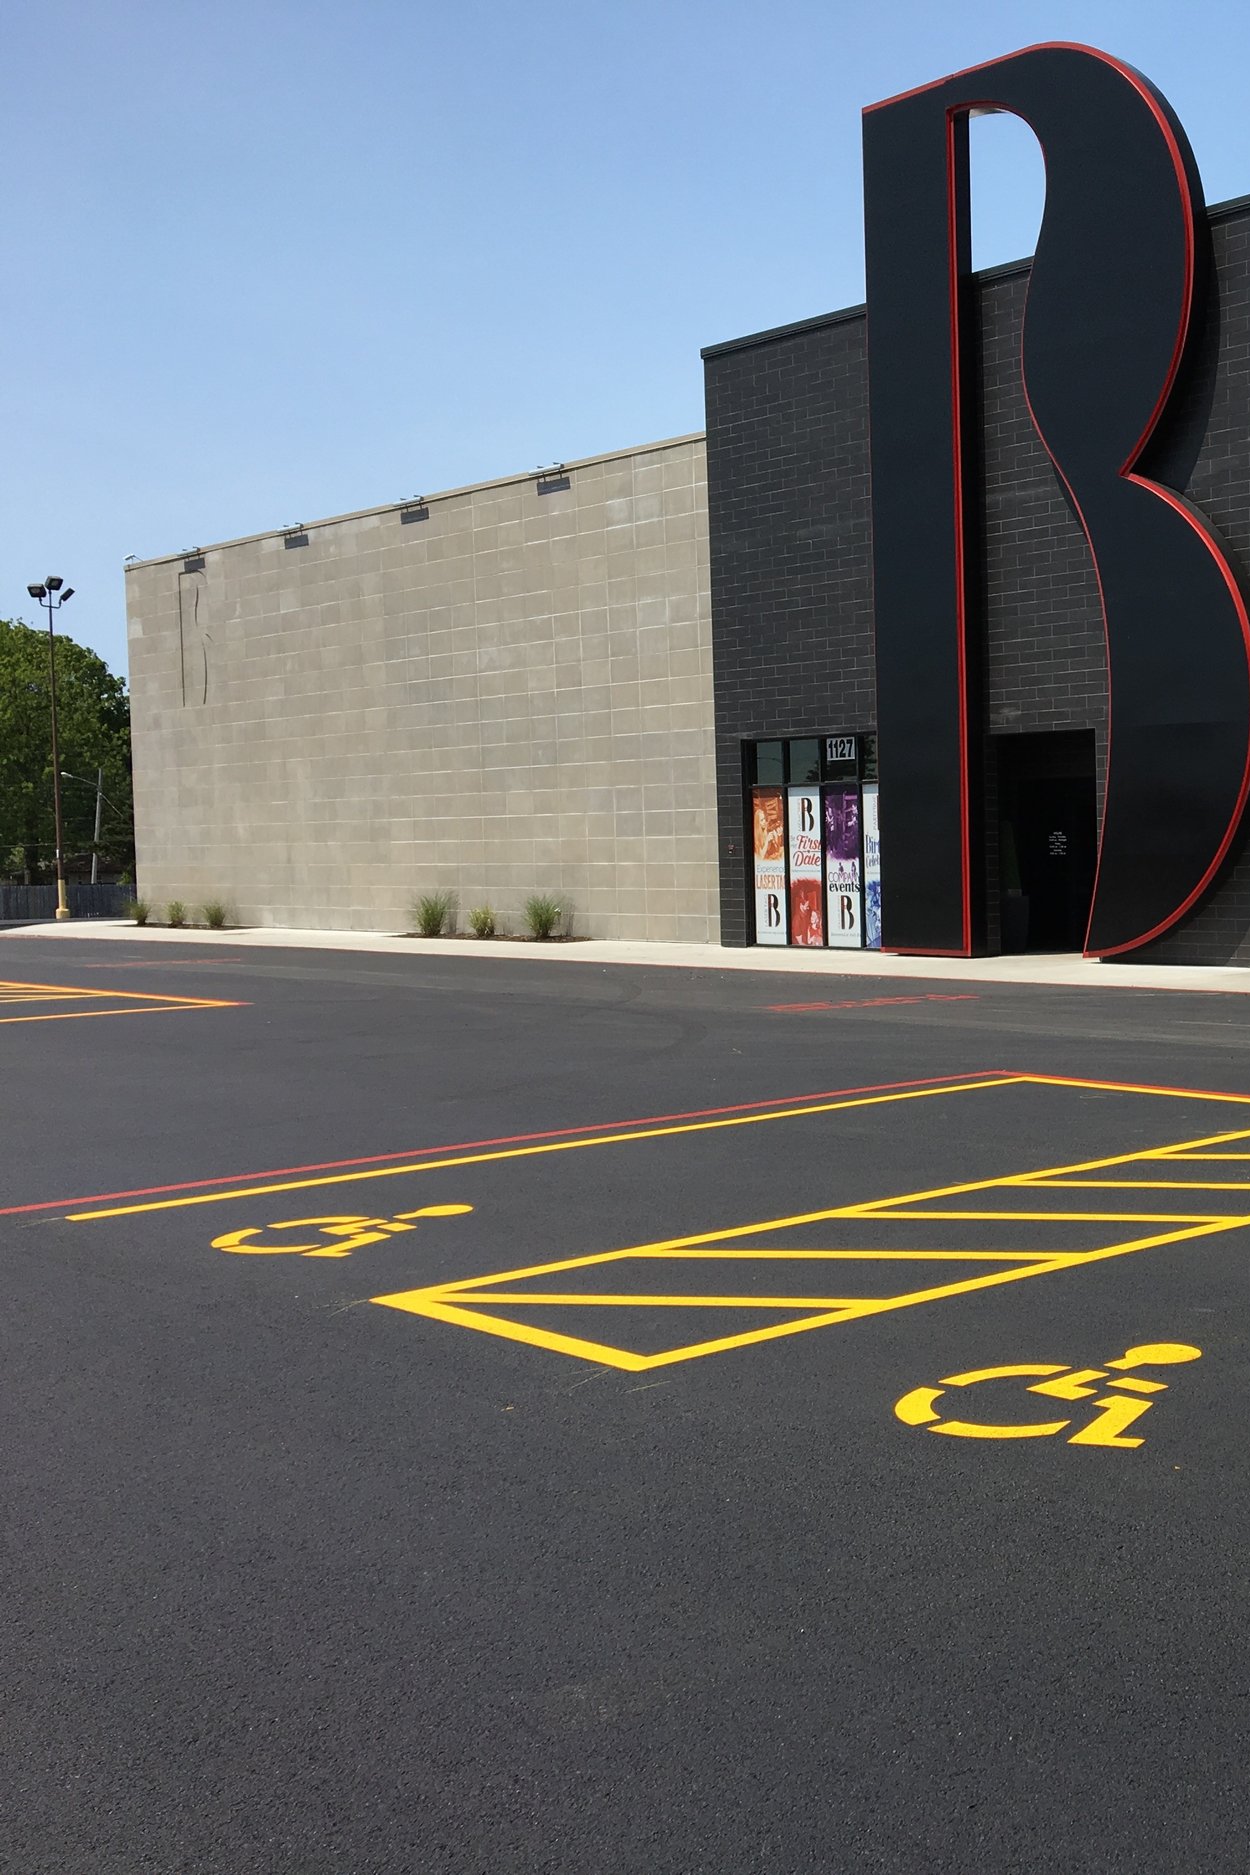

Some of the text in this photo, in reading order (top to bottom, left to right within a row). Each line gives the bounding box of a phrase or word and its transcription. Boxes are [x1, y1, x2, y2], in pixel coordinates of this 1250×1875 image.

[828, 739, 853, 758] 1127
[801, 798, 815, 832] B
[792, 851, 821, 867] Date
[776, 874, 785, 890] TA
[829, 881, 861, 893] events
[768, 893, 780, 928] B
[841, 895, 855, 931] B
